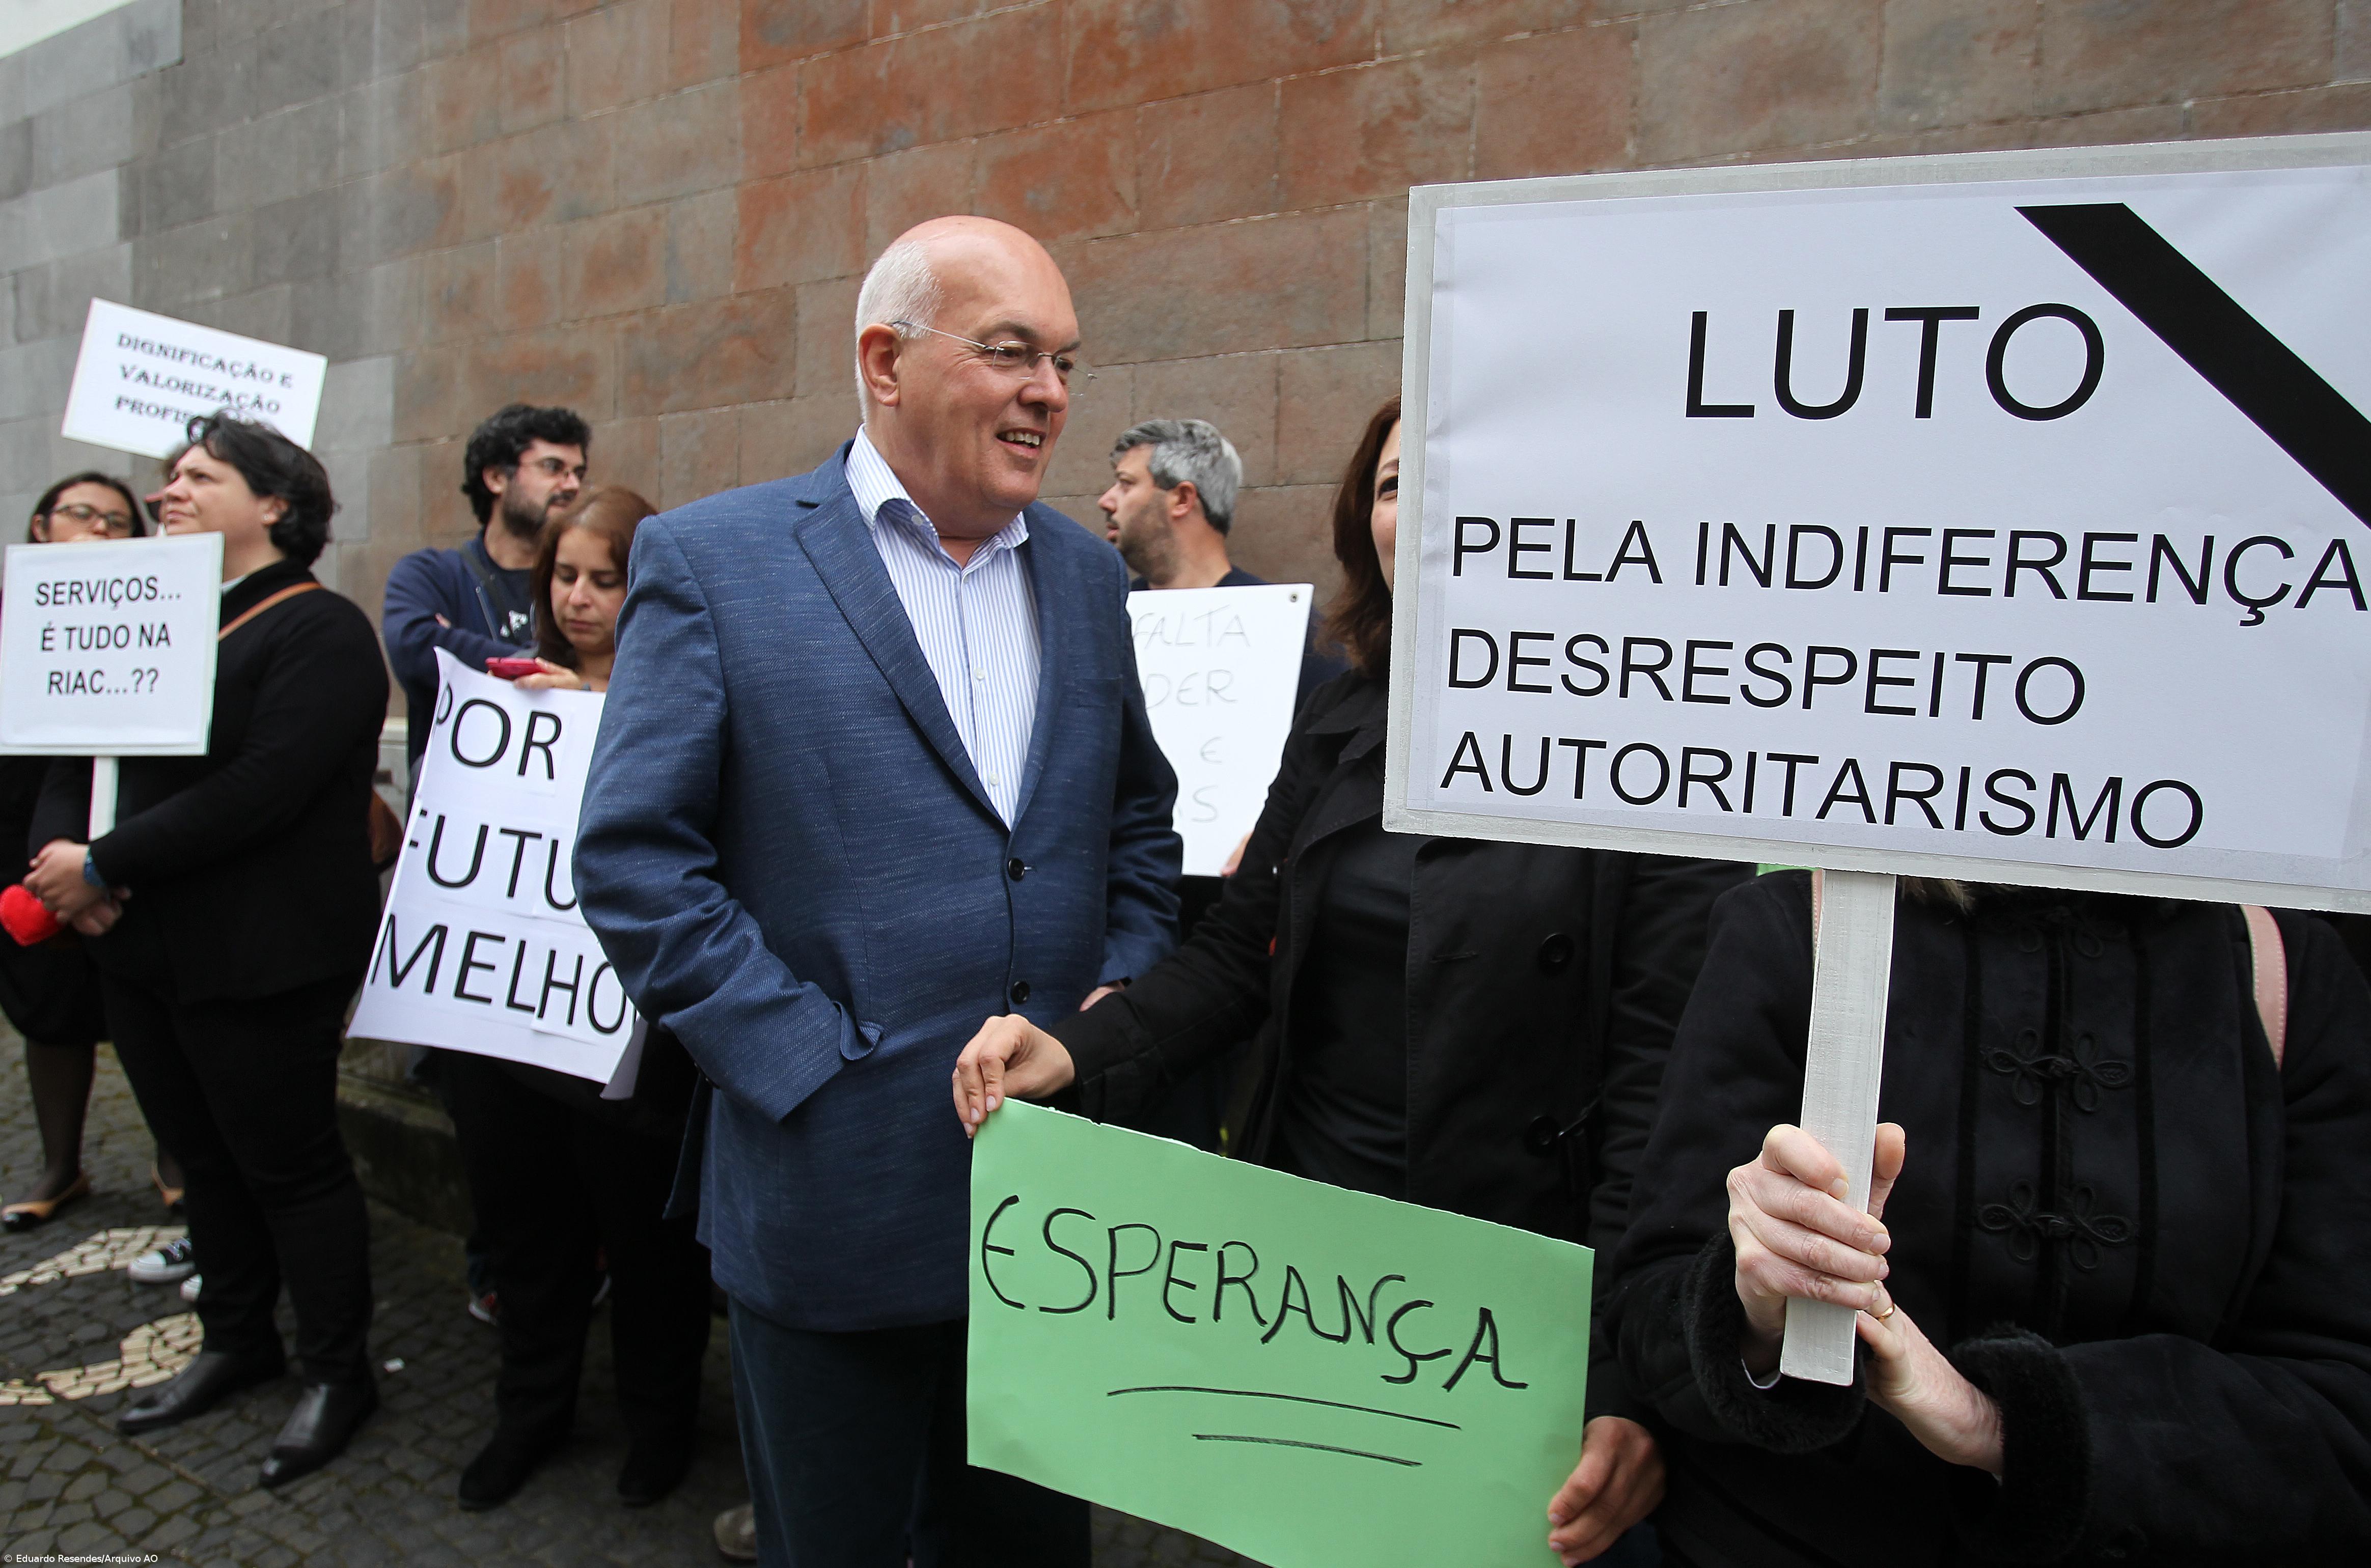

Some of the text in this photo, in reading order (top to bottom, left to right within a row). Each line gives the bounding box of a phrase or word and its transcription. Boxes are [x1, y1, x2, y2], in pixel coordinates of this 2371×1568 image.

[117, 332, 292, 387] DIGNIFICAÇÃO E
[119, 363, 280, 413] VALORIZAÇÃO
[1685, 303, 2105, 421] LUTO
[36, 576, 181, 610] SERVIÇOS...
[1452, 516, 2369, 627] PELA INDIFERENÇA
[41, 621, 171, 651] É TUDO NA
[47, 669, 159, 695] RIAC...??
[1447, 628, 2087, 726] DESRESPEITO
[1200, 737, 1223, 764] E
[1439, 731, 2204, 851] AUTORITARISMO
[409, 808, 577, 910] UTU
[372, 914, 638, 1034] MELHO
[982, 1194, 1528, 1392] ESPERANÇA
